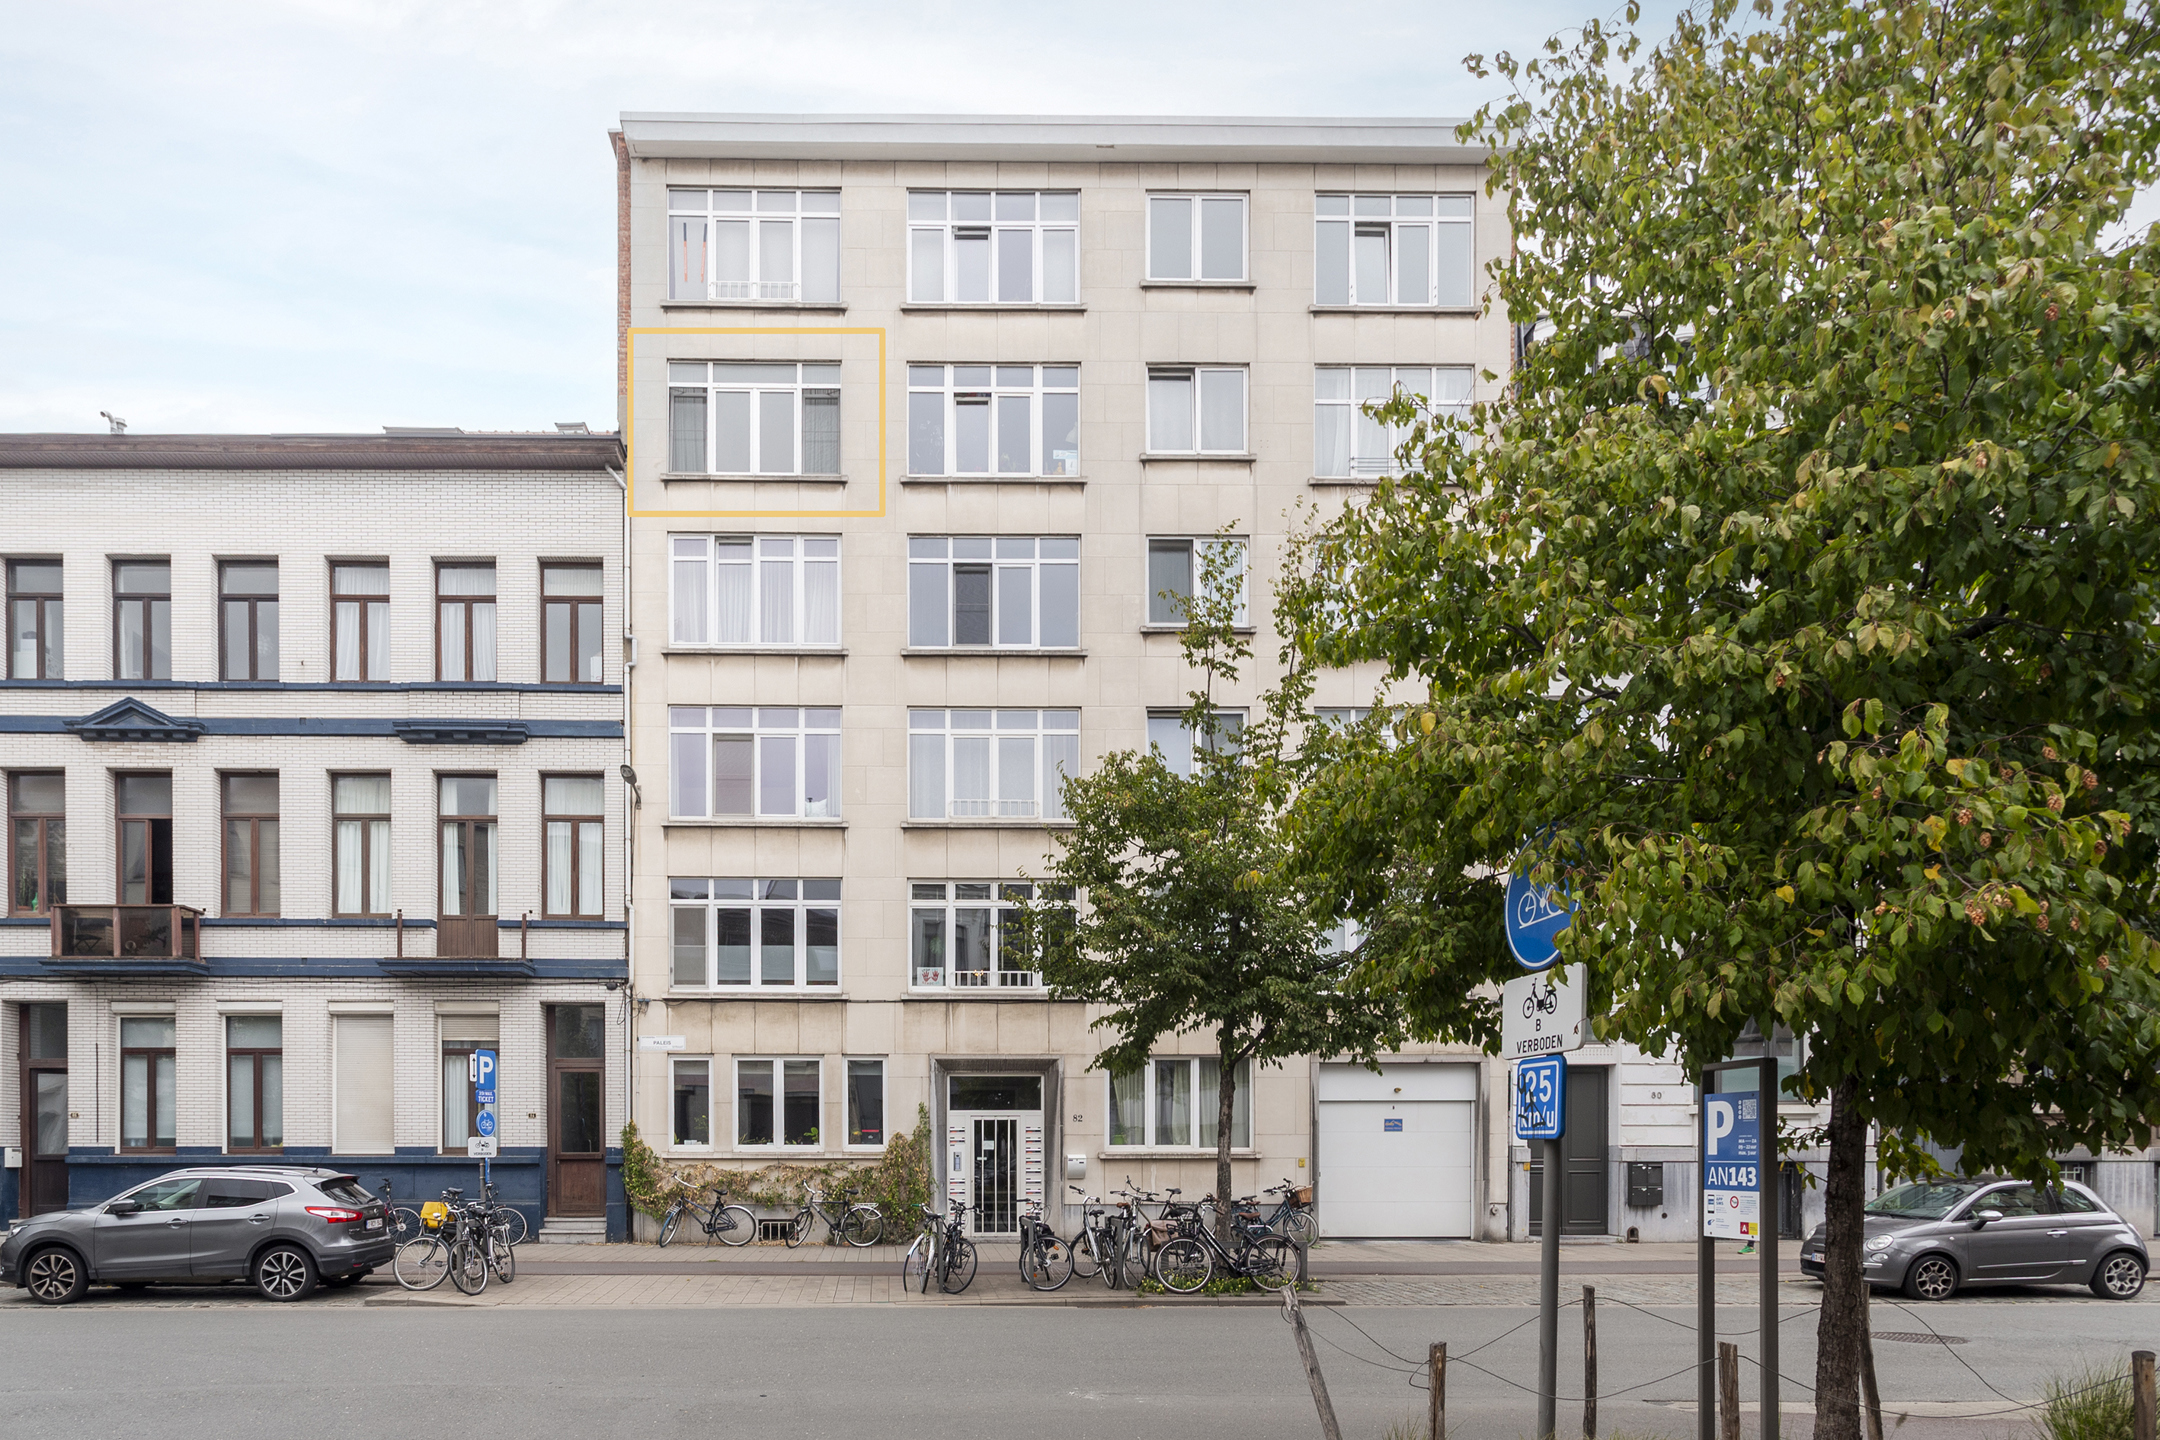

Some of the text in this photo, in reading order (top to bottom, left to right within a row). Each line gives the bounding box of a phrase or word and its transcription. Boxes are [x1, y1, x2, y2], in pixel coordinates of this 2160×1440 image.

[1535, 1018, 1542, 1032] B
[1516, 1033, 1564, 1054] VERBODEN
[480, 1056, 493, 1084] P
[1525, 1069, 1552, 1103] 25
[1651, 1091, 1662, 1100] 80
[1073, 1114, 1083, 1122] 82
[1519, 1105, 1555, 1128] km/u
[1708, 1101, 1734, 1155] P
[1707, 1166, 1757, 1187] AN143
[1741, 1224, 1748, 1233] A
